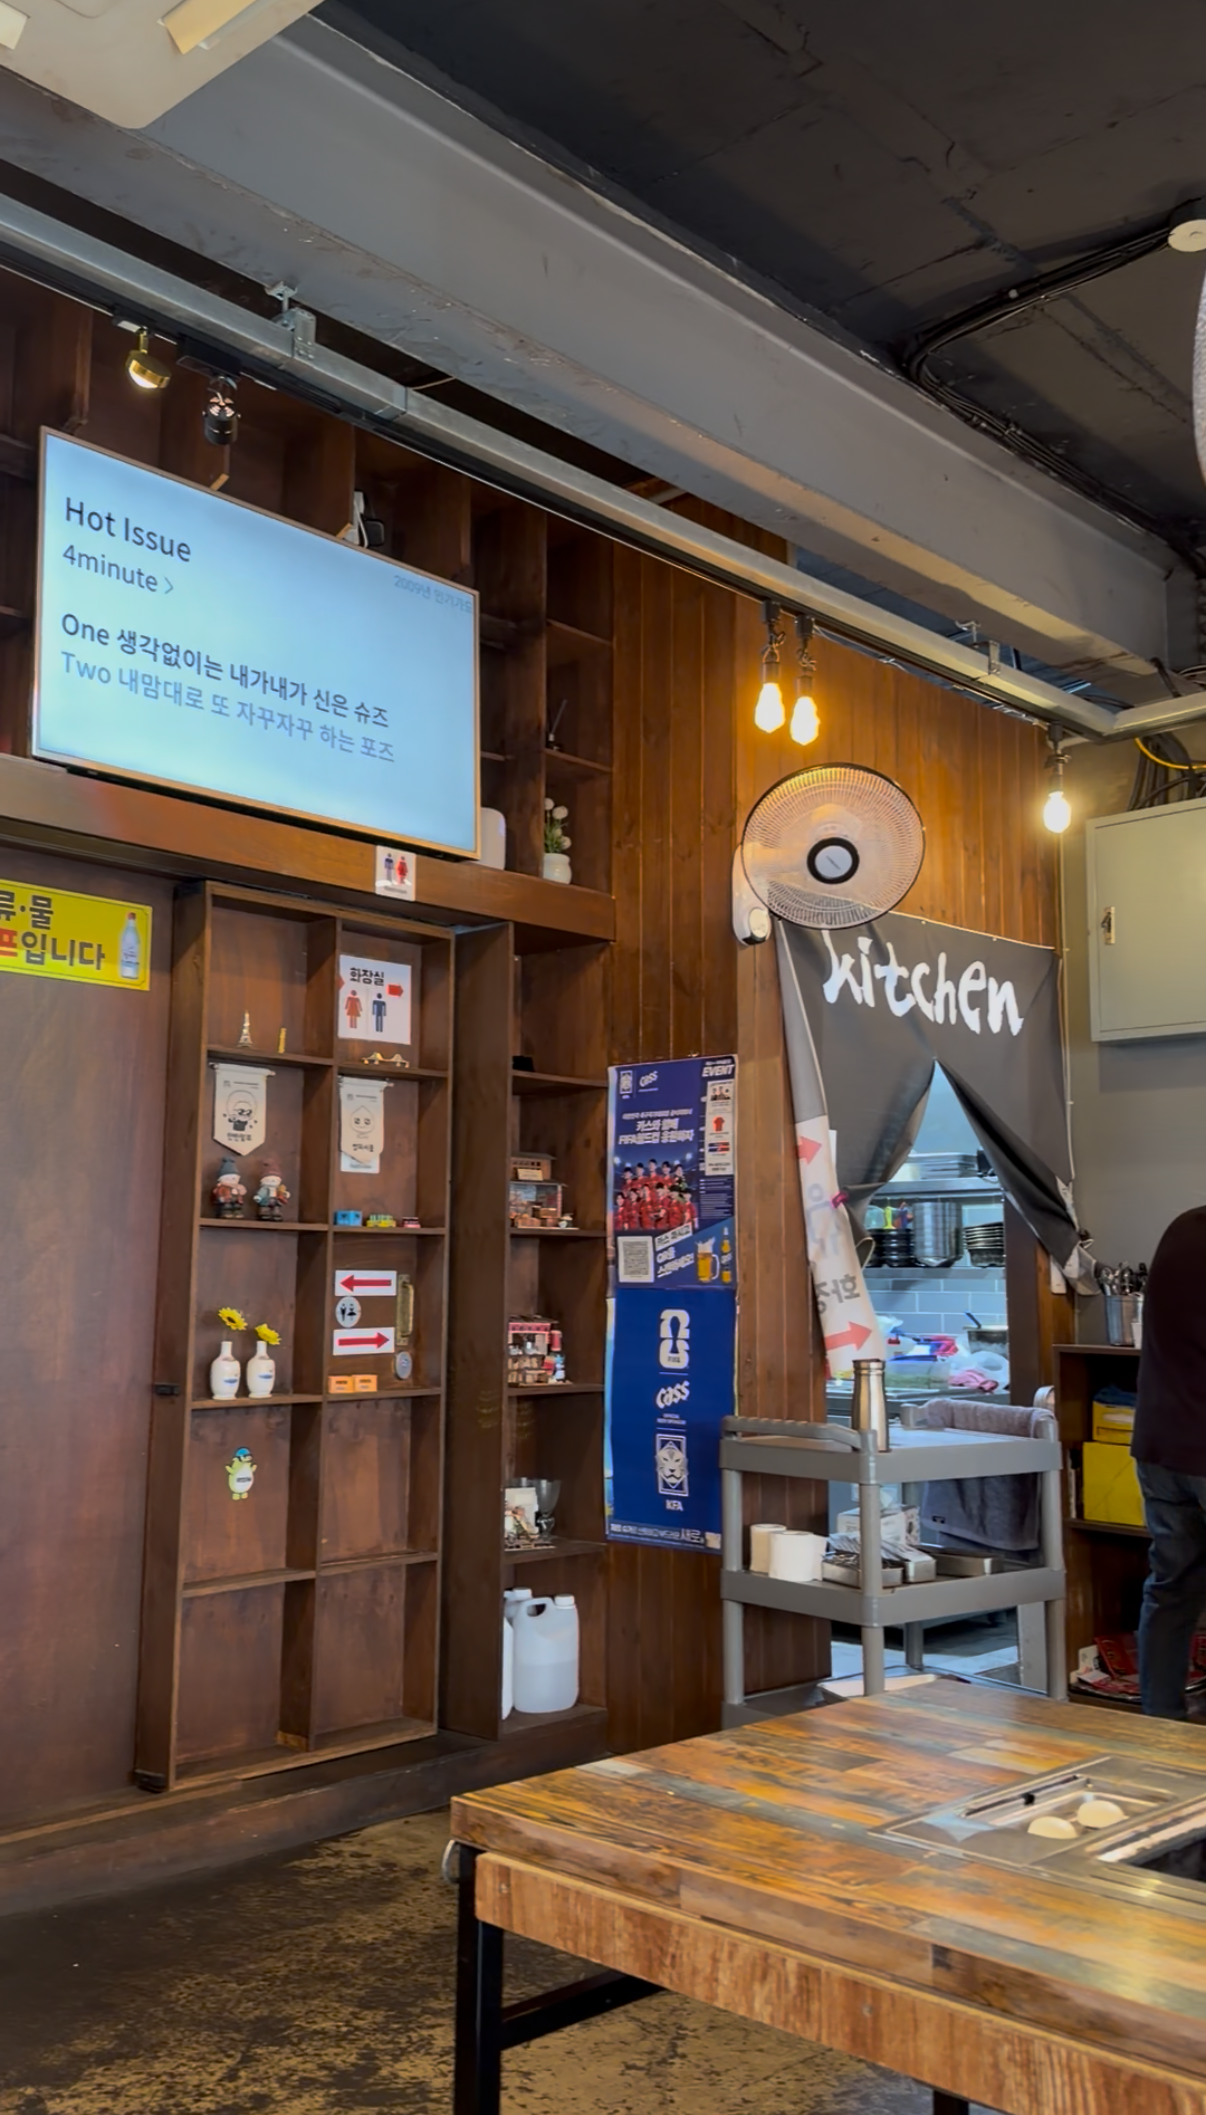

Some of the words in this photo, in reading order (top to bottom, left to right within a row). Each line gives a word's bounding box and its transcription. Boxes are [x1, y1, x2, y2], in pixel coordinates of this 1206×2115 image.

[66, 497, 116, 538] Hot
[124, 517, 191, 562] Issue
[62, 545, 158, 592] 4minute
[394, 574, 431, 599] 2009년
[62, 613, 110, 646] One
[117, 629, 223, 681] 생각없이는
[230, 663, 308, 706] 내가내가
[313, 689, 349, 718] 신은
[354, 702, 389, 728] 슈즈
[61, 651, 111, 684] Two
[118, 668, 205, 710] 내맘대로
[210, 693, 230, 717] 또
[237, 701, 313, 741] 자꾸자꾸
[319, 724, 355, 753] 하는
[361, 736, 394, 763] 포즈
[350, 967, 385, 986] 화장실
[822, 930, 1024, 1036] kitchen
[702, 1064, 735, 1077] EVENT
[666, 1499, 684, 1511] KFA
